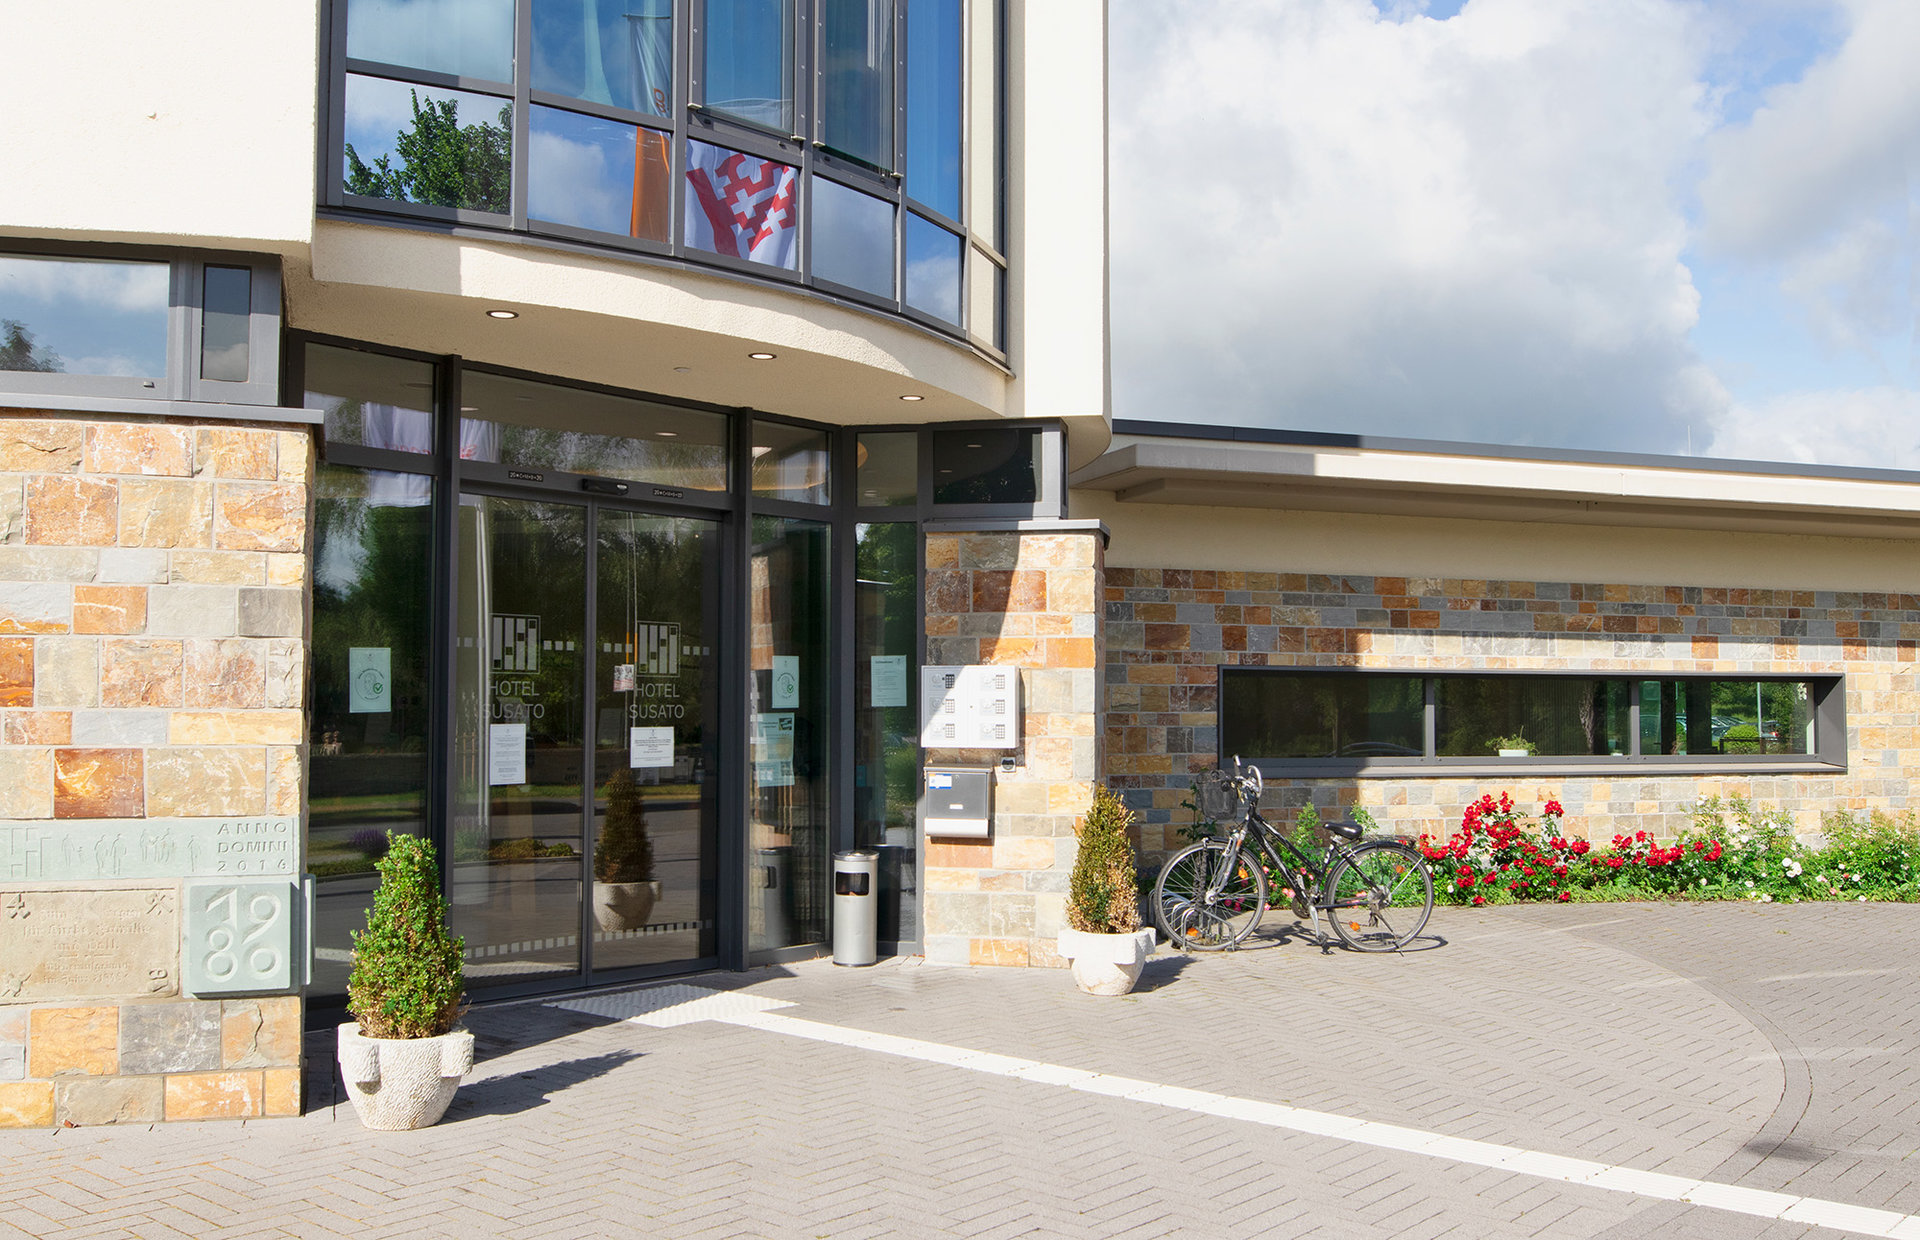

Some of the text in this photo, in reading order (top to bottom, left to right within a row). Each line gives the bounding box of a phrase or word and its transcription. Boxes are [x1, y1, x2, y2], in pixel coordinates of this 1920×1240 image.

[489, 680, 540, 697] HOTEL
[635, 683, 680, 698] HOTEL
[482, 703, 545, 719] SUSATO
[629, 704, 685, 719] SUSATO
[217, 822, 287, 835] ANNO
[217, 840, 287, 853] DOMINI
[217, 858, 287, 872] 2016
[205, 886, 281, 945] 19
[203, 925, 282, 983] 80
